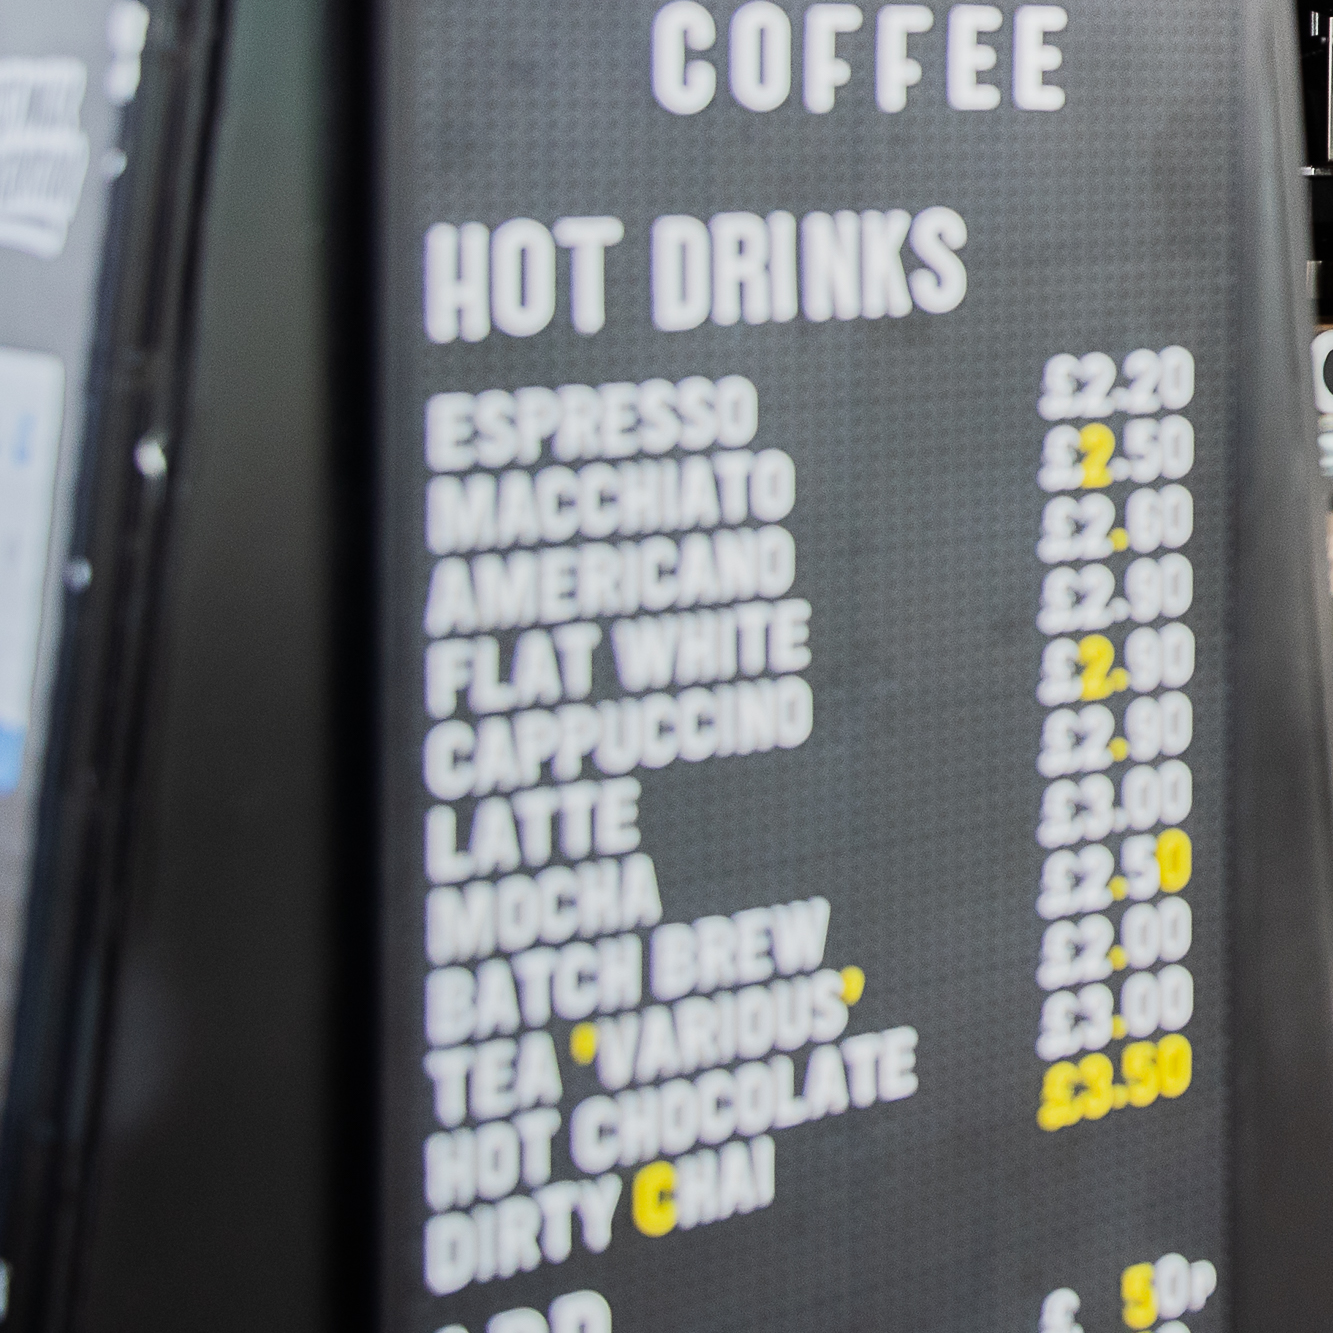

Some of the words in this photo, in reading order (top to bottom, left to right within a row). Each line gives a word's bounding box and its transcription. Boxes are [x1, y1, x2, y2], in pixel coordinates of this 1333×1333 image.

[652, 0, 1068, 115] COFFEE
[425, 214, 625, 344] HOT
[651, 205, 968, 332] DRINKS
[426, 375, 758, 472] ESPRESSO
[1036, 345, 1195, 421] £2.20
[425, 448, 796, 555] MACCHIATO
[1036, 414, 1195, 492] £2.50
[425, 525, 796, 638] AMERICANO
[426, 623, 600, 719] FLAT
[613, 598, 812, 693] WHITE
[425, 675, 814, 801] CAPPUCCINO
[426, 777, 642, 884] LATTE
[426, 853, 662, 965] MOCHA
[1036, 759, 1194, 849] £3.00
[426, 934, 641, 1046] BATCH
[651, 897, 831, 1000] BREW
[1037, 828, 1194, 921] £2.50
[425, 1032, 563, 1127] TEA
[1037, 897, 1194, 990] £2.00
[425, 1108, 561, 1211] HOT
[571, 1026, 920, 1174] CHOCOLATE
[1037, 964, 1194, 1062] £3.00
[425, 1174, 622, 1296] DIRTY
[633, 1135, 775, 1237] CHAI
[1037, 1033, 1194, 1131] £3.50
